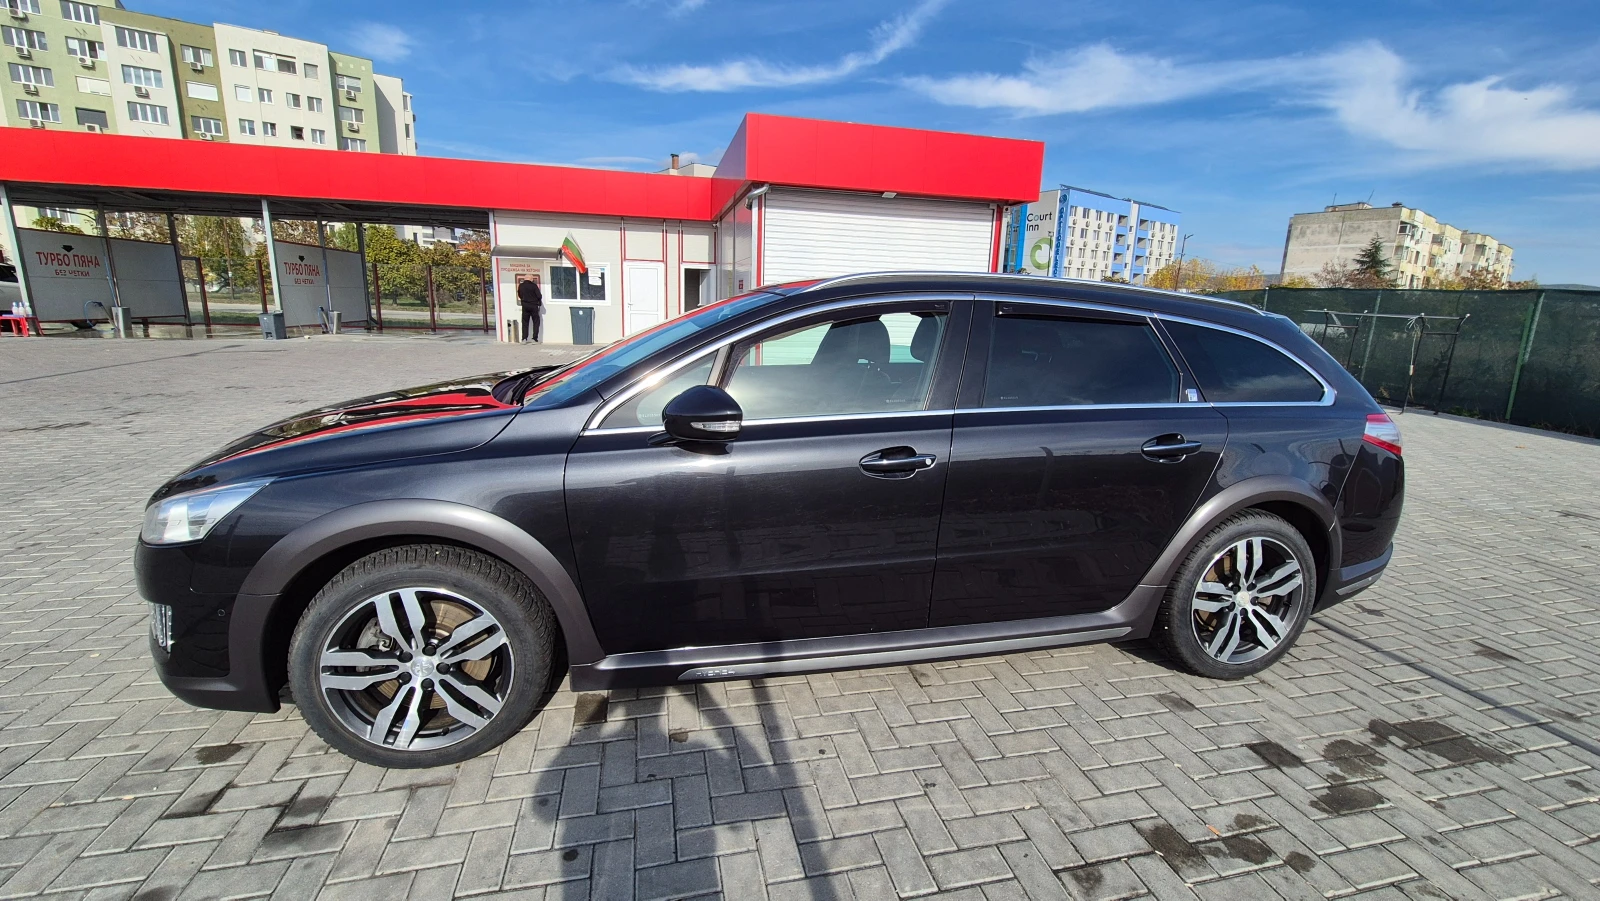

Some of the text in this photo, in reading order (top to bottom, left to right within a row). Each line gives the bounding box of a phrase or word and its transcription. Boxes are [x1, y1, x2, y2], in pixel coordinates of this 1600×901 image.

[1026, 212, 1053, 222] Court
[36, 251, 101, 268] ТУРБО ПЯНА
[55, 269, 67, 277] БЕЗ
[283, 262, 321, 277] ТУРБО ПЯНА
